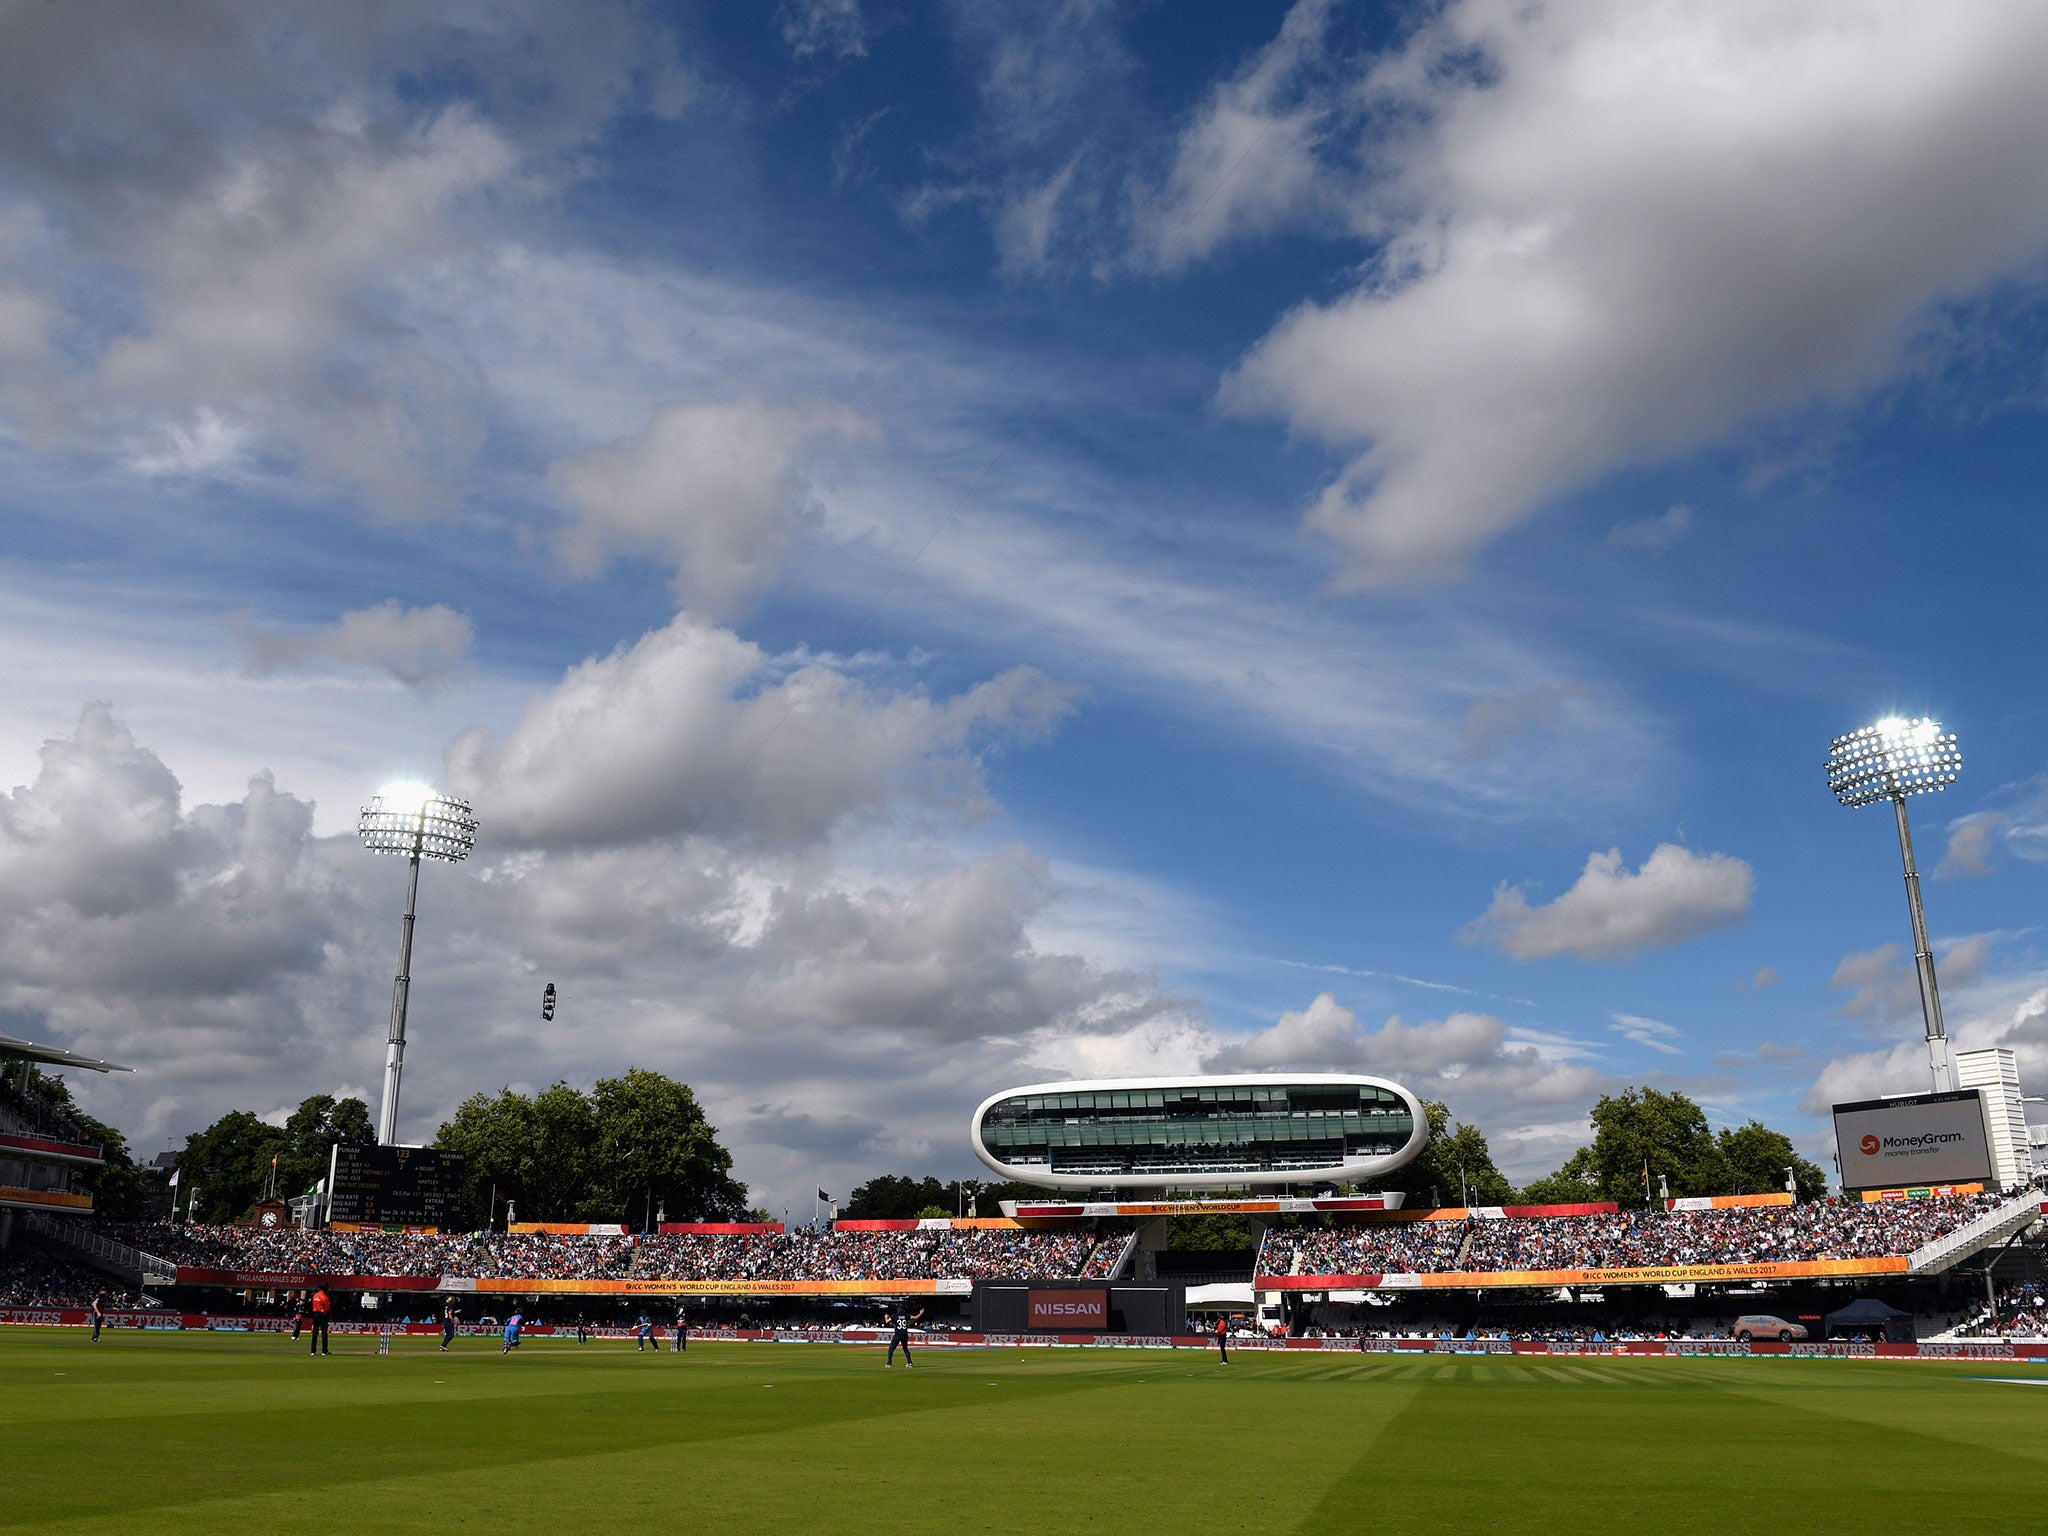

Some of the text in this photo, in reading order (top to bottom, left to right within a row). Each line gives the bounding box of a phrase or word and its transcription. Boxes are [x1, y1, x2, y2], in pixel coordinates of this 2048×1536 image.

[1889, 1100, 1917, 1108] HUBLOT
[396, 1150, 410, 1158] 133
[1885, 1147, 1940, 1157] money transfer
[236, 1273, 264, 1281] ENGLAND
[1602, 1271, 1640, 1279] WOMEN'S
[1642, 1270, 1671, 1278] WORLD
[1689, 1268, 1725, 1276] ENGLAND
[1034, 1303, 1101, 1315] NISSAN
[11, 1311, 61, 1324] TYRES
[136, 1314, 183, 1328] TYRES
[206, 1316, 297, 1330] MRF TYRES
[328, 1321, 367, 1332] MRF
[367, 1322, 407, 1333] TYRES
[897, 1319, 906, 1329] 39
[593, 1327, 630, 1337] TYRES
[702, 1329, 738, 1339] TYRES
[772, 1330, 808, 1340] MRF
[808, 1331, 844, 1341] TYRES
[912, 1333, 950, 1342] TYRES
[983, 1334, 1020, 1344] MRF
[1021, 1335, 1060, 1344] TYRES
[1093, 1335, 1172, 1346] MRF TYRES
[1248, 1339, 1287, 1348] TYRES
[1321, 1339, 1359, 1349] MRF
[1434, 1341, 1473, 1351] MRF
[1473, 1341, 1512, 1352] TYRES
[1546, 1342, 1584, 1352] MRF
[1664, 1342, 1707, 1354] MRF
[1708, 1343, 1752, 1354] TYRES
[1789, 1343, 1831, 1355] MRF
[1832, 1343, 1876, 1355] TYRES
[1917, 1344, 2015, 1357] MRF TYRES
